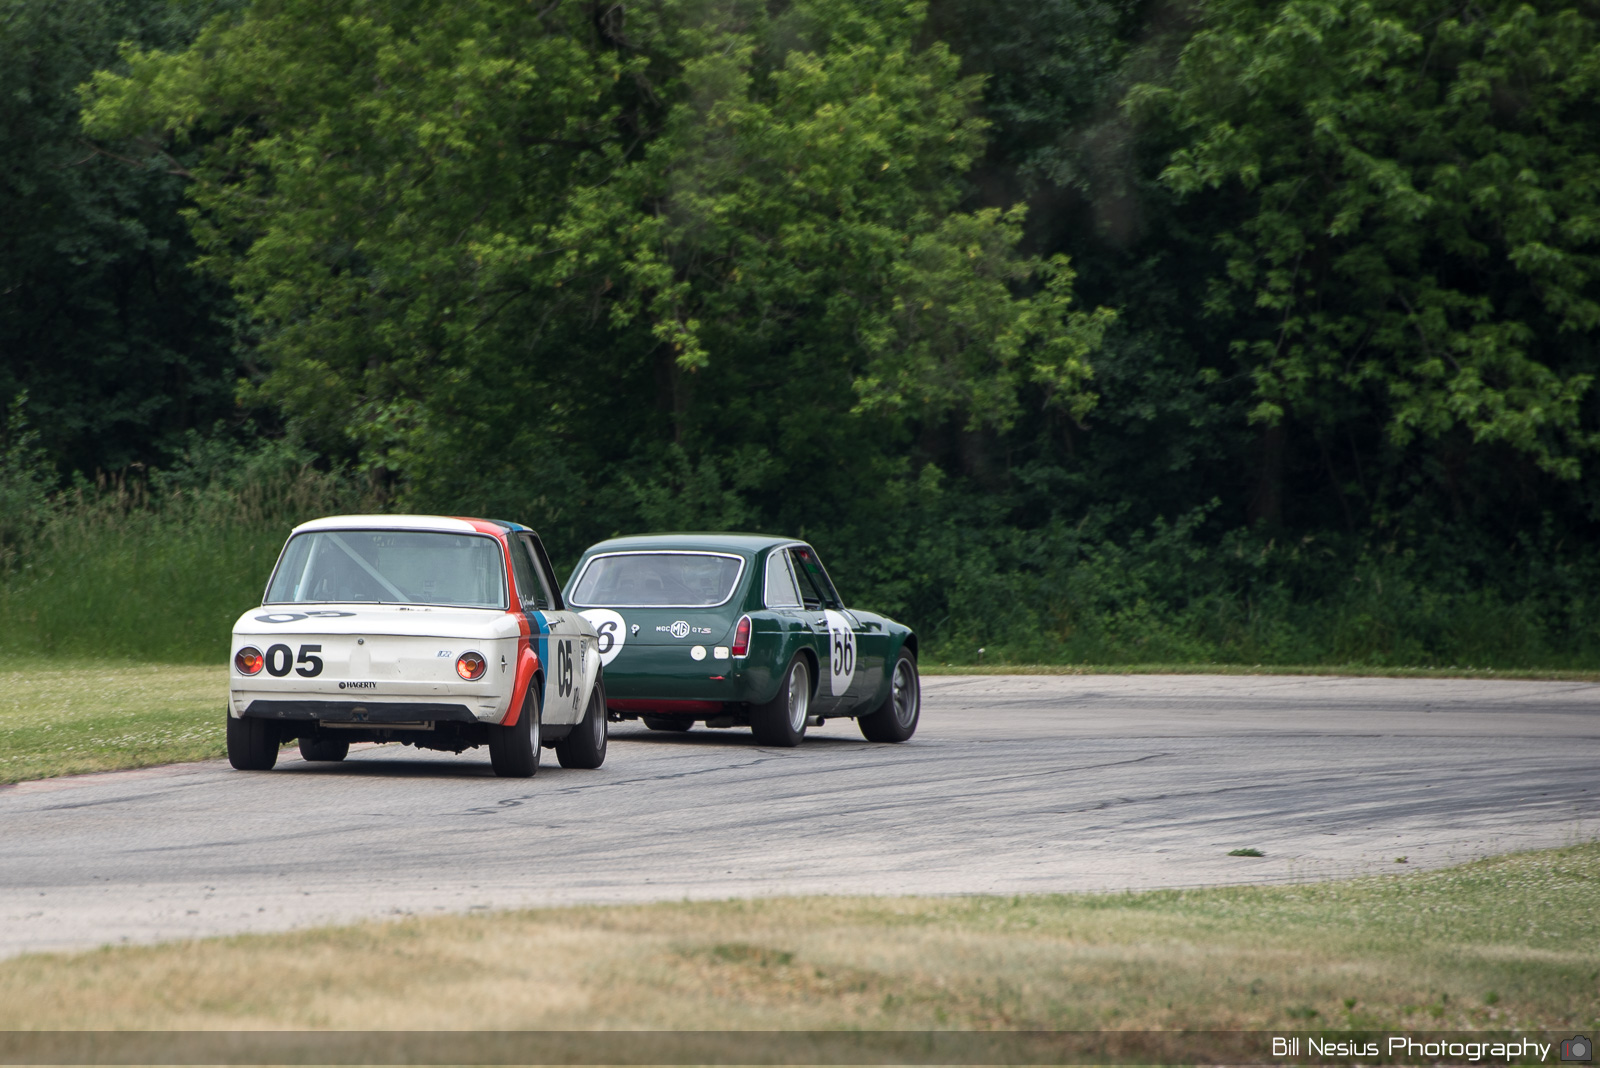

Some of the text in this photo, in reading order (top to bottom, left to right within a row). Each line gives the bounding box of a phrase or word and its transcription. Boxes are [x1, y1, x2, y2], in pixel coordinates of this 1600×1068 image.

[265, 643, 324, 678] 05
[557, 639, 573, 698] 05
[832, 627, 853, 676] 56
[346, 681, 377, 689] HAGERTY
